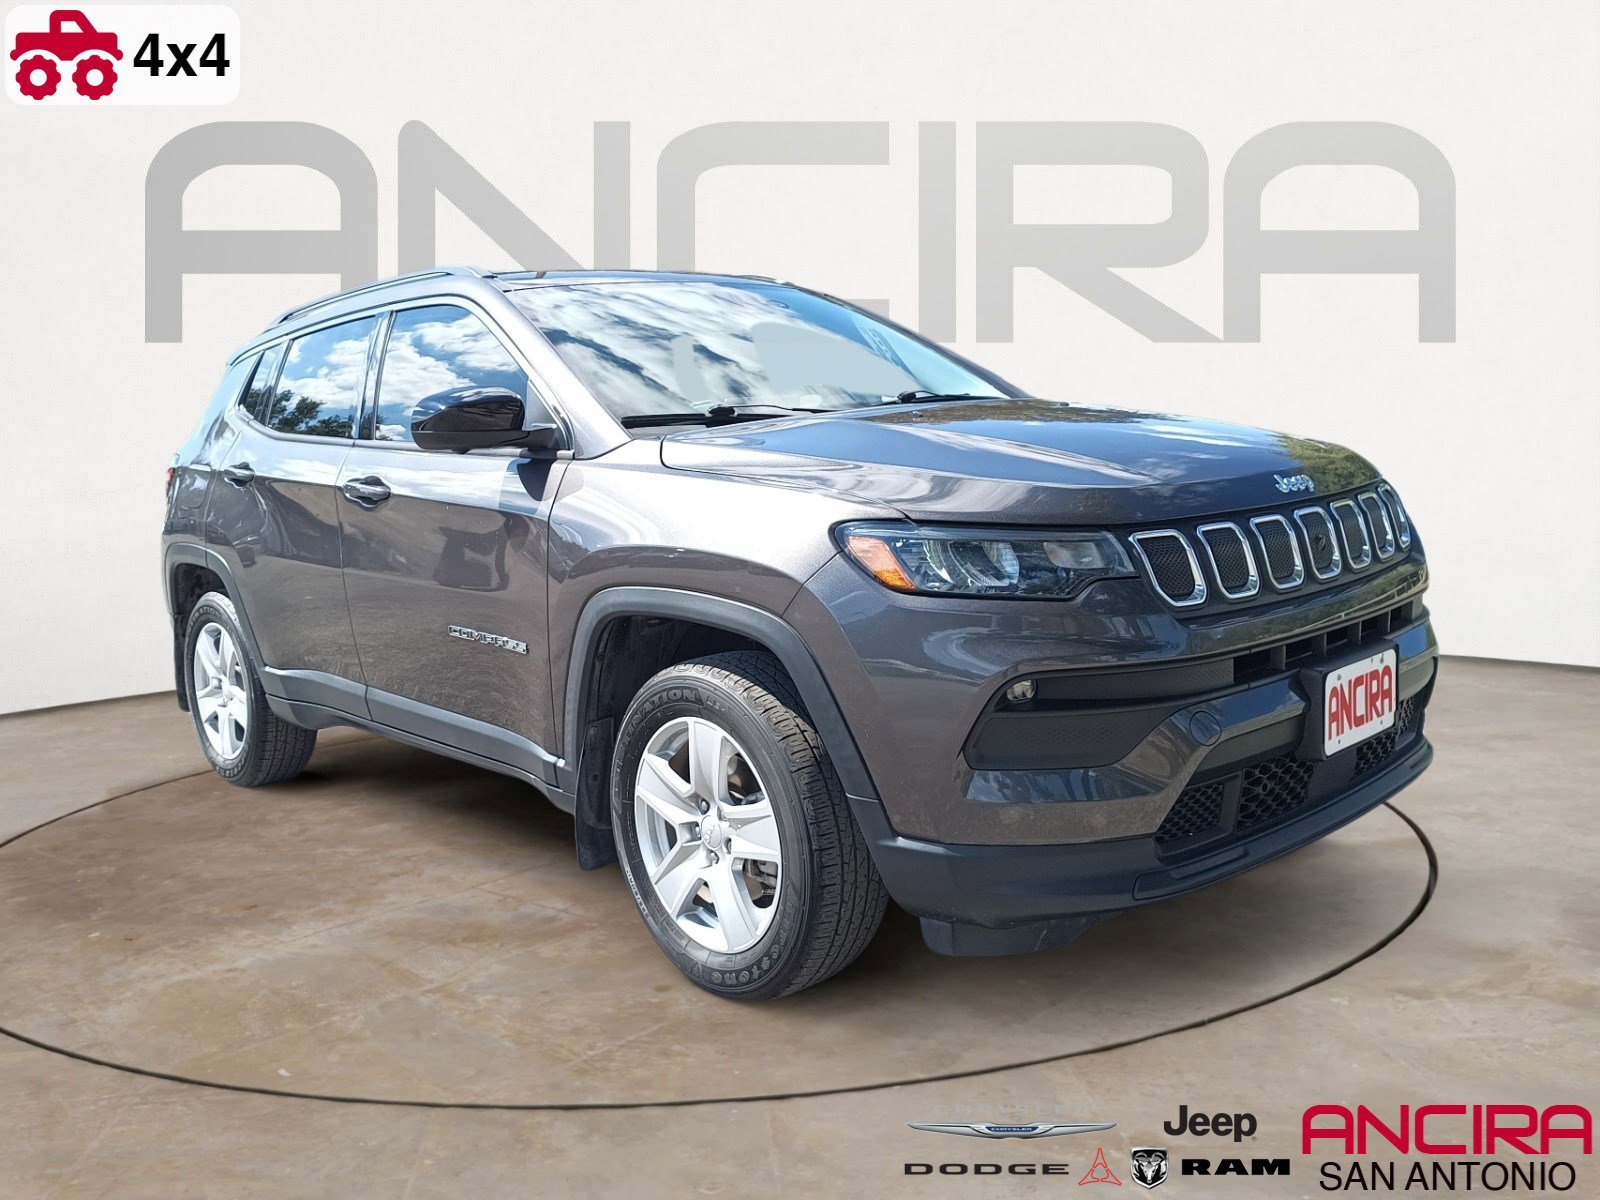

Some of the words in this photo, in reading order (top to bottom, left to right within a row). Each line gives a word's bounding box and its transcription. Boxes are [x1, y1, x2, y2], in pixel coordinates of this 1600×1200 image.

[145, 120, 1457, 343] ANCIRA
[1273, 474, 1315, 493] Jeep
[448, 625, 528, 655] COMPASS
[1328, 665, 1393, 742] ANCIRA
